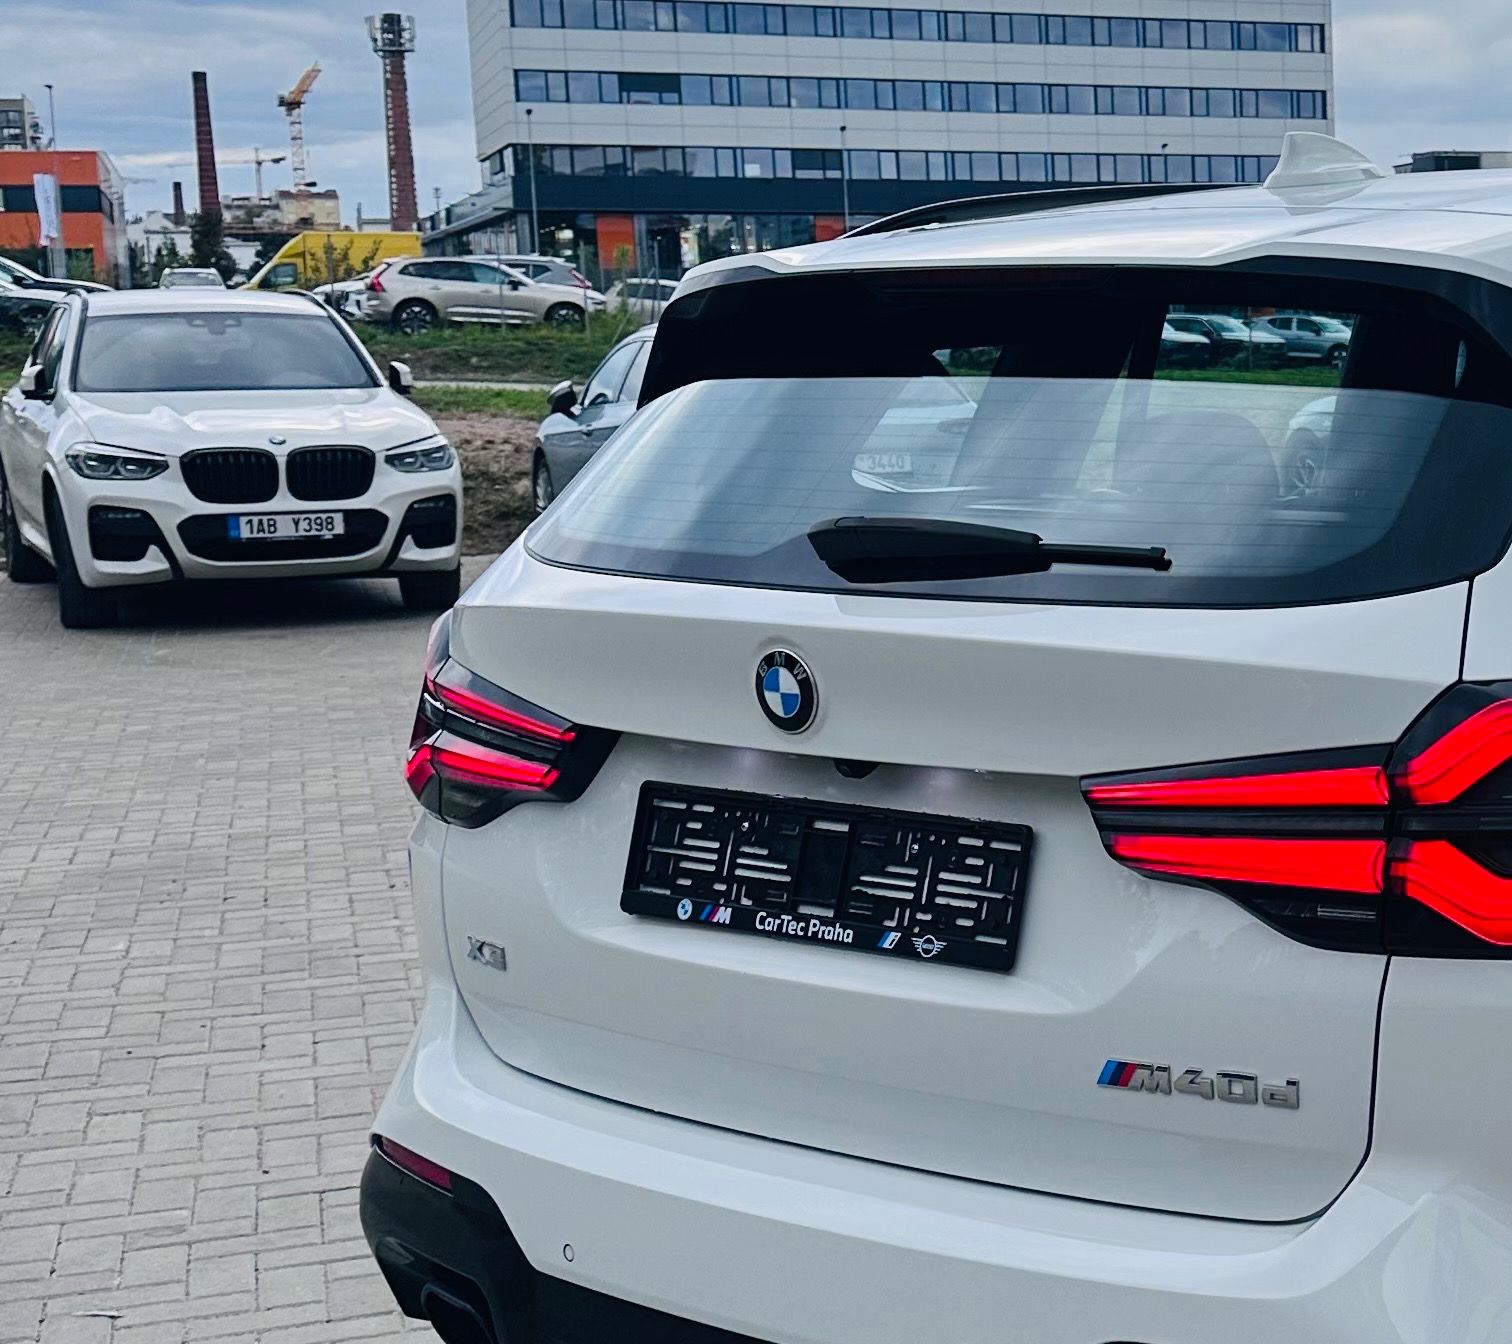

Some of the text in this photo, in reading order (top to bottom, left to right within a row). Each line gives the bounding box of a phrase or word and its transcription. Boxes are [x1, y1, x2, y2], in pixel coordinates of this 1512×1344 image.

[245, 516, 335, 535] 1AB Y398
[758, 652, 807, 680] BMW
[755, 911, 854, 943] CarTec Praha
[467, 935, 507, 972] X3
[1128, 1063, 1300, 1109] M40d
